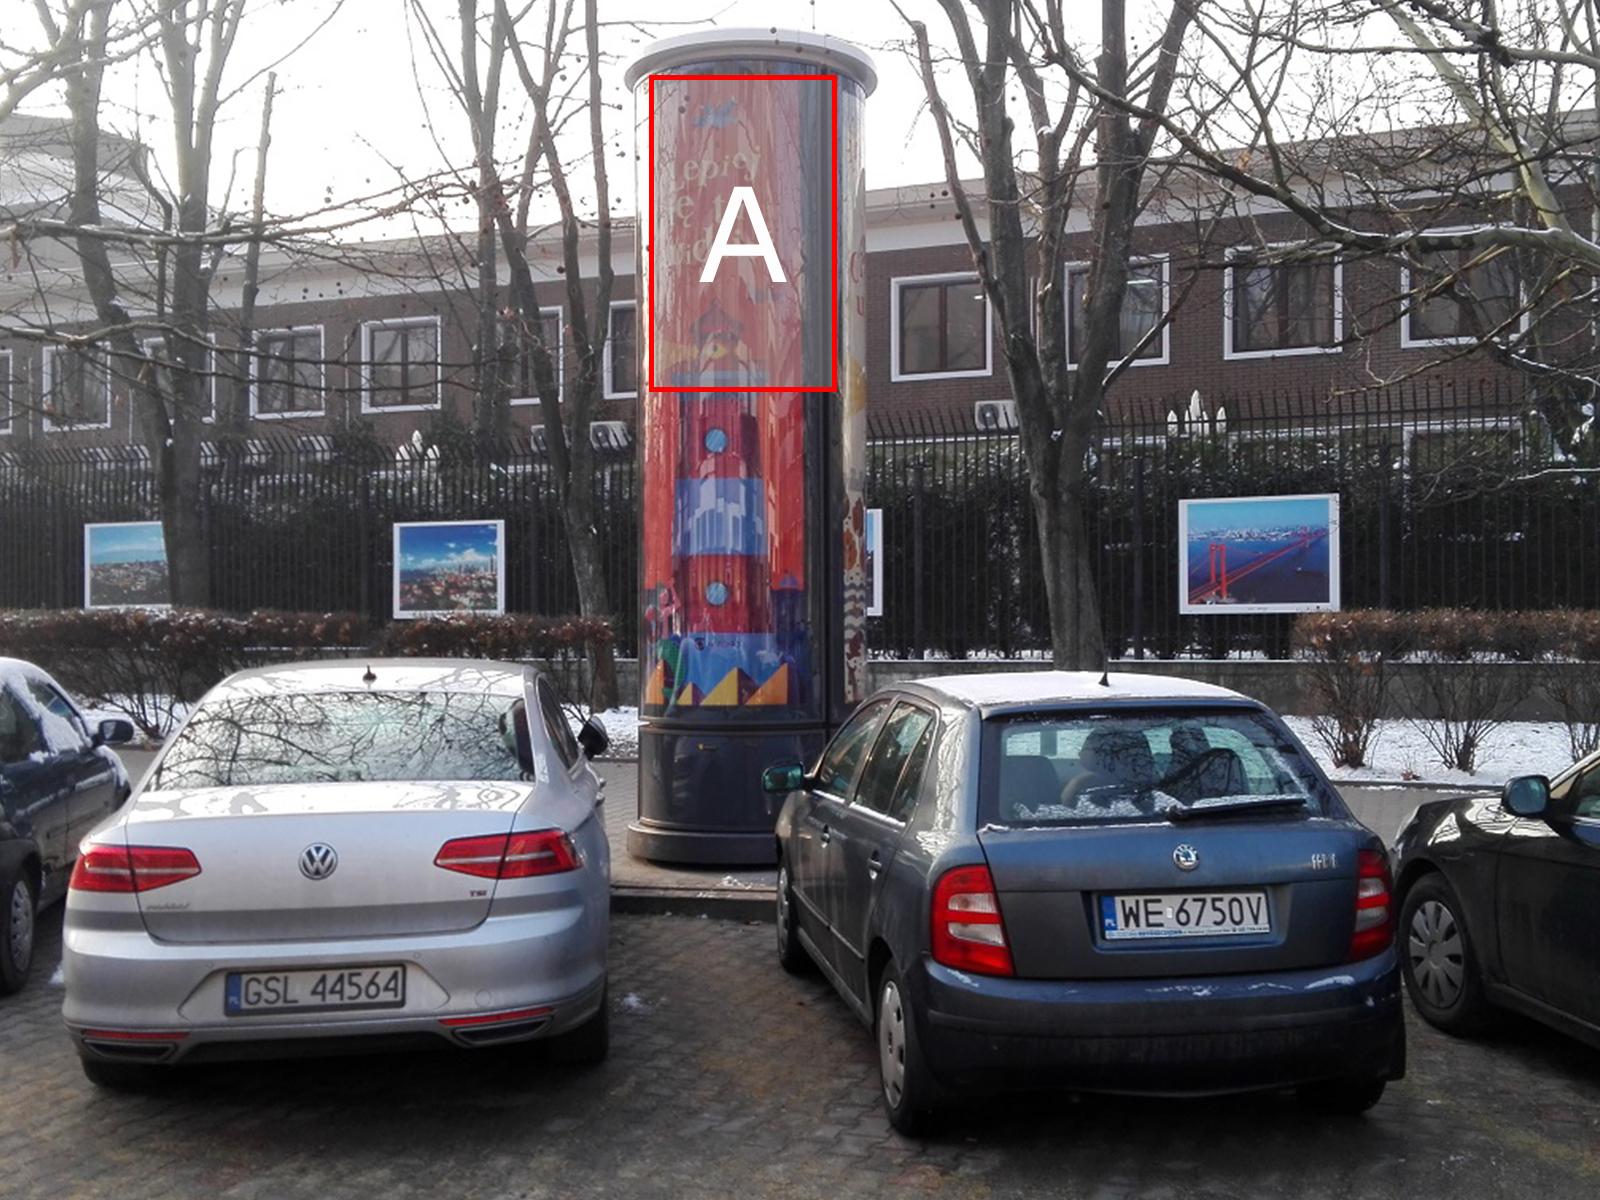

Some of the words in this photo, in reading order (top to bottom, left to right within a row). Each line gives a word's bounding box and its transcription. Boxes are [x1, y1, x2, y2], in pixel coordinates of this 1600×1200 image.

[1121, 898, 1164, 928] WE
[1175, 896, 1262, 927] 6750V
[244, 975, 299, 1006] GSL
[310, 970, 399, 1002] 44564
